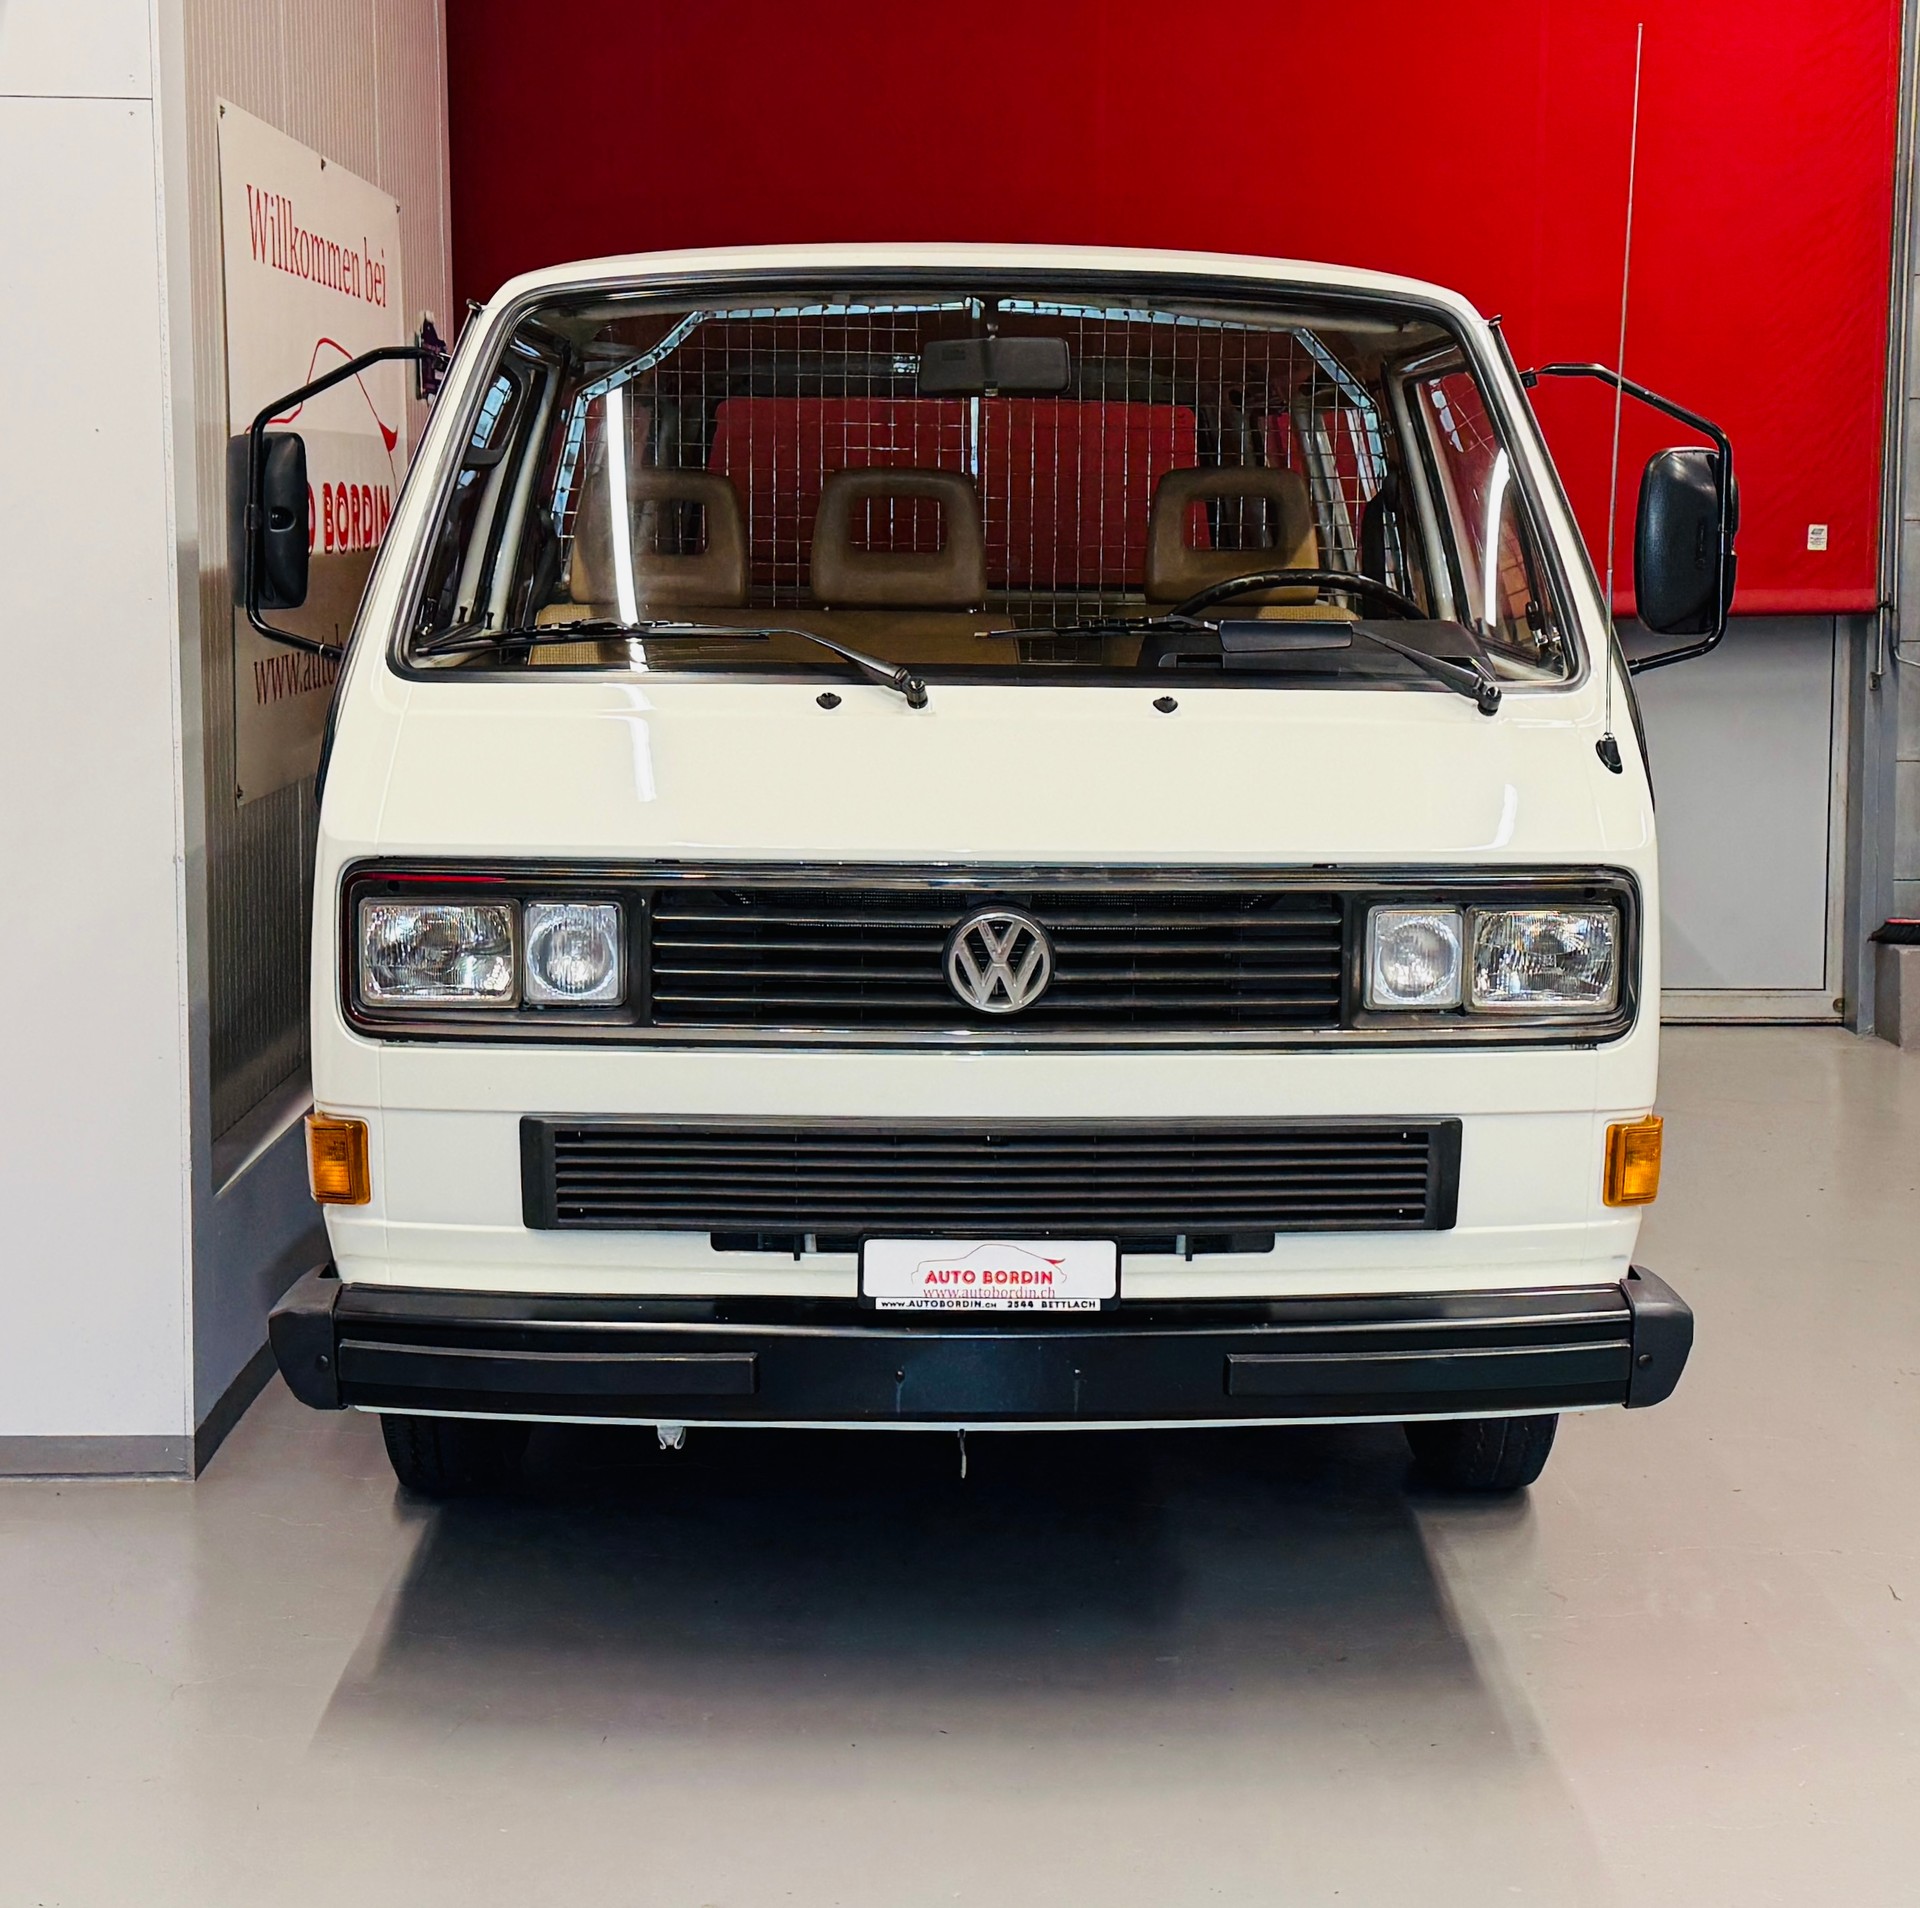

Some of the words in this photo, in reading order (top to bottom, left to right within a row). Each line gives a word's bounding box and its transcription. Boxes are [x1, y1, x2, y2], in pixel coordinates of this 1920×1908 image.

[246, 184, 361, 299] Willkommen
[364, 236, 386, 308] bei
[323, 481, 391, 555] BORDIN
[924, 1270, 976, 1284] AUTO
[982, 1270, 1053, 1284] BORDIN
[923, 1286, 1056, 1299] www.autobordin.ch
[1041, 1300, 1096, 1309] BETTLACH
